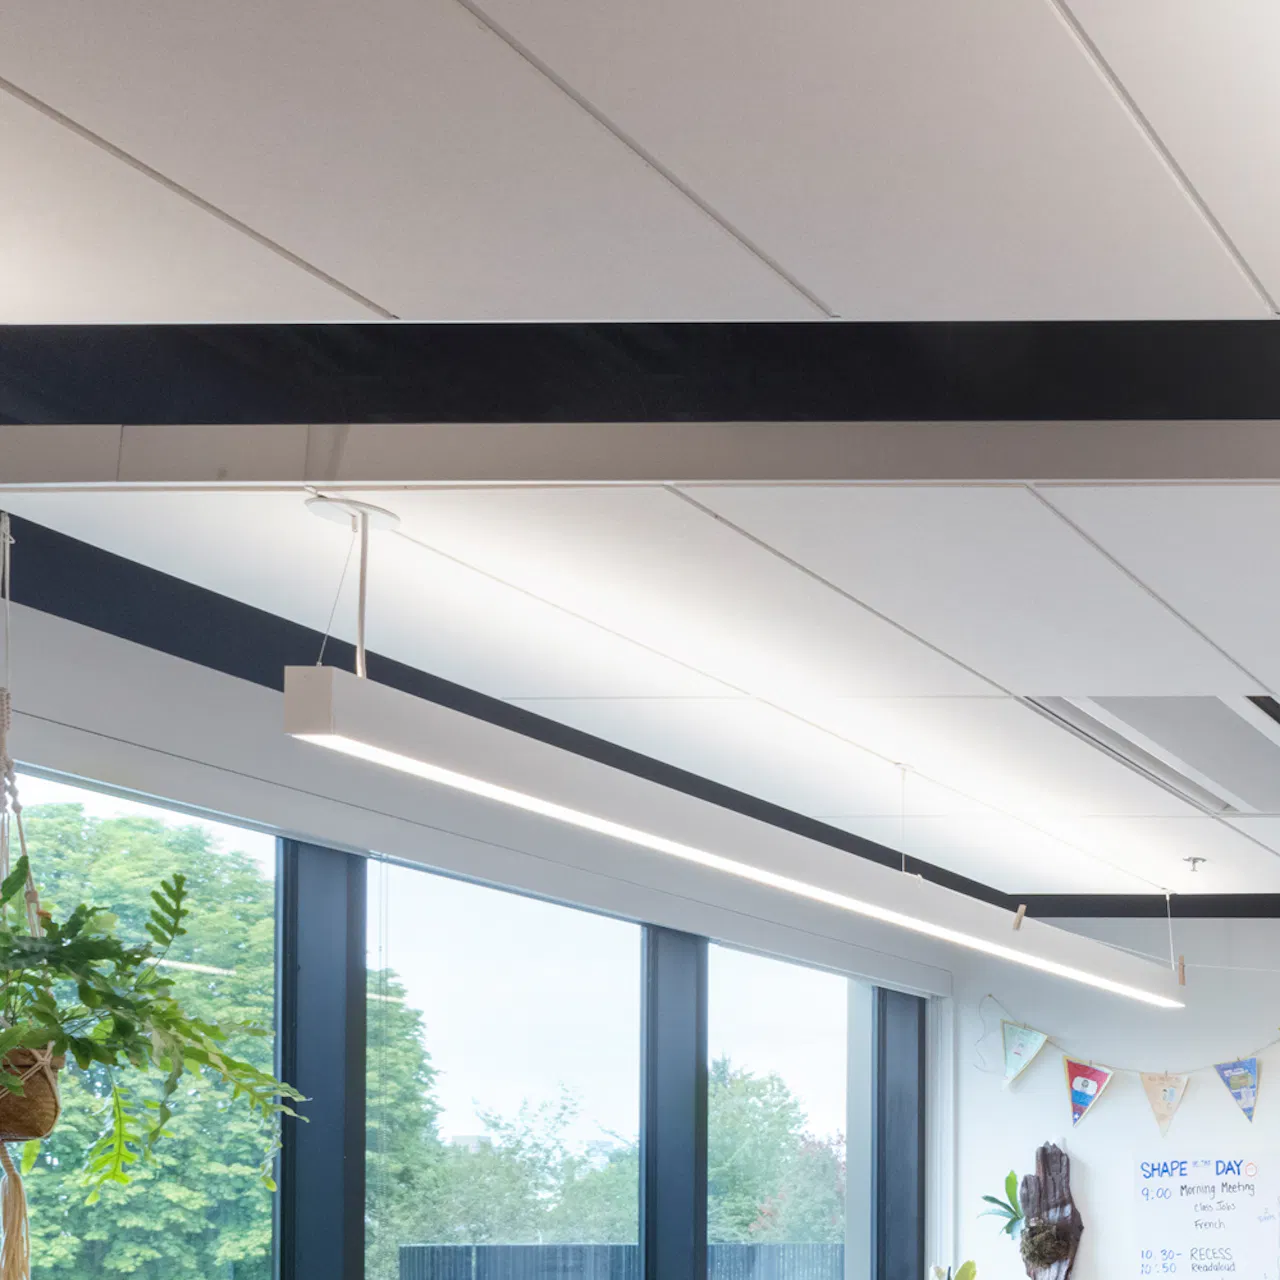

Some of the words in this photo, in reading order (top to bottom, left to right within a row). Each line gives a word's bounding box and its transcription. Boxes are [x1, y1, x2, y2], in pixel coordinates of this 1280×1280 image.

[1140, 1160, 1188, 1179] SHAPE
[1216, 1160, 1244, 1176] DAY
[1141, 1187, 1172, 1201] 9:00
[1180, 1184, 1215, 1200] Morning
[1221, 1182, 1255, 1197] Meeting
[1194, 1219, 1225, 1229] French
[1190, 1248, 1233, 1261] RECESS
